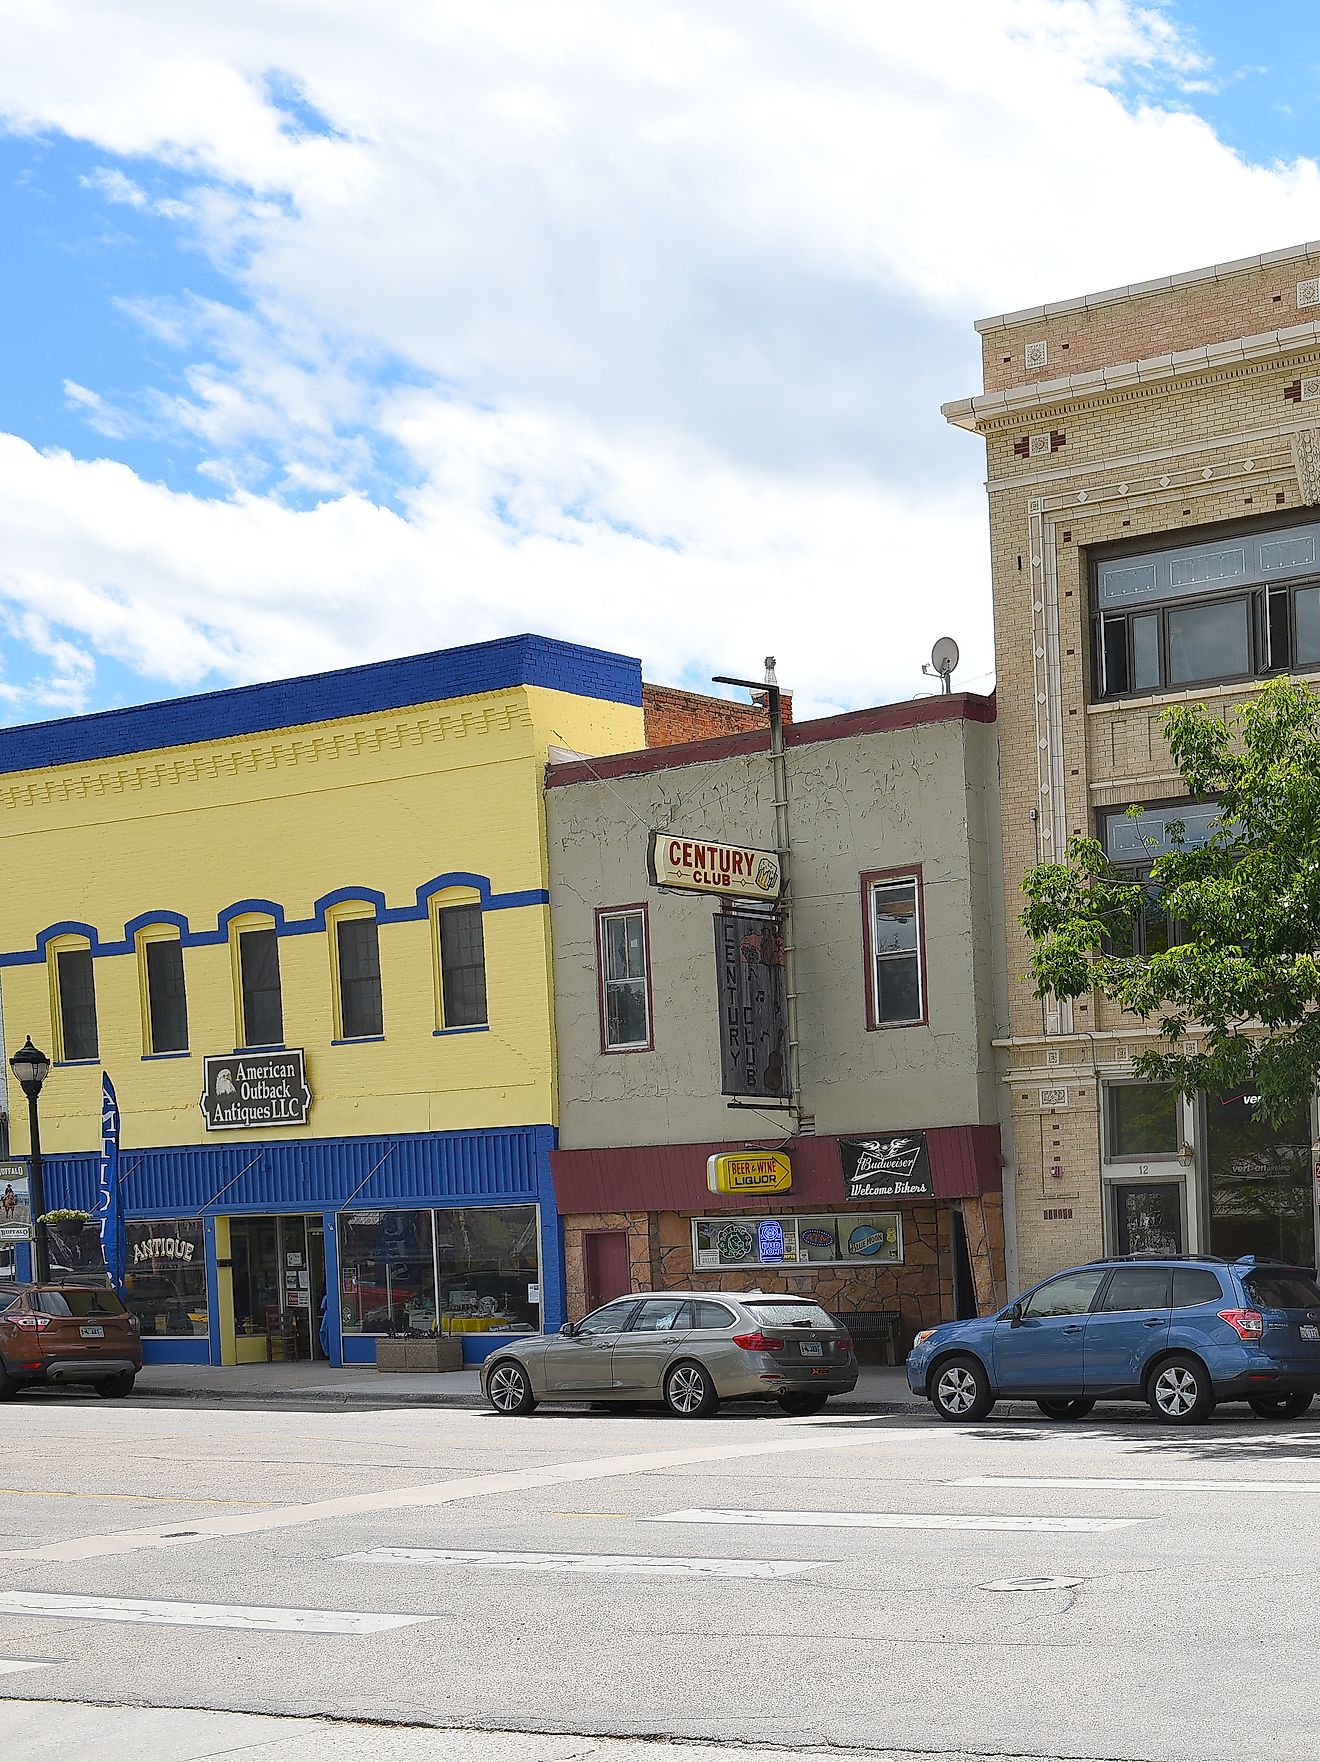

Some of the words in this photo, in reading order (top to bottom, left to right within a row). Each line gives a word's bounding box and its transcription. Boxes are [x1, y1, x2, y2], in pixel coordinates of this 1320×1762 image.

[669, 841, 755, 876] CENTURY
[693, 871, 731, 887] CLUB
[724, 924, 741, 1067] CENTURY
[743, 1007, 758, 1086] CLUB
[235, 1061, 295, 1081] American
[241, 1079, 291, 1100] Outback
[213, 1102, 271, 1125] Antiques
[271, 1098, 300, 1119] LLC
[0, 1166, 24, 1176] UFFALO
[732, 1162, 750, 1175] BEER
[757, 1161, 777, 1174] WINE
[857, 1156, 914, 1171] Budweiser
[1139, 1165, 1149, 1175] 12
[735, 1175, 776, 1186] LIQUOR
[850, 1183, 893, 1196] Welcome
[894, 1180, 928, 1195] Bikers
[133, 1238, 195, 1264] ANTIQUE
